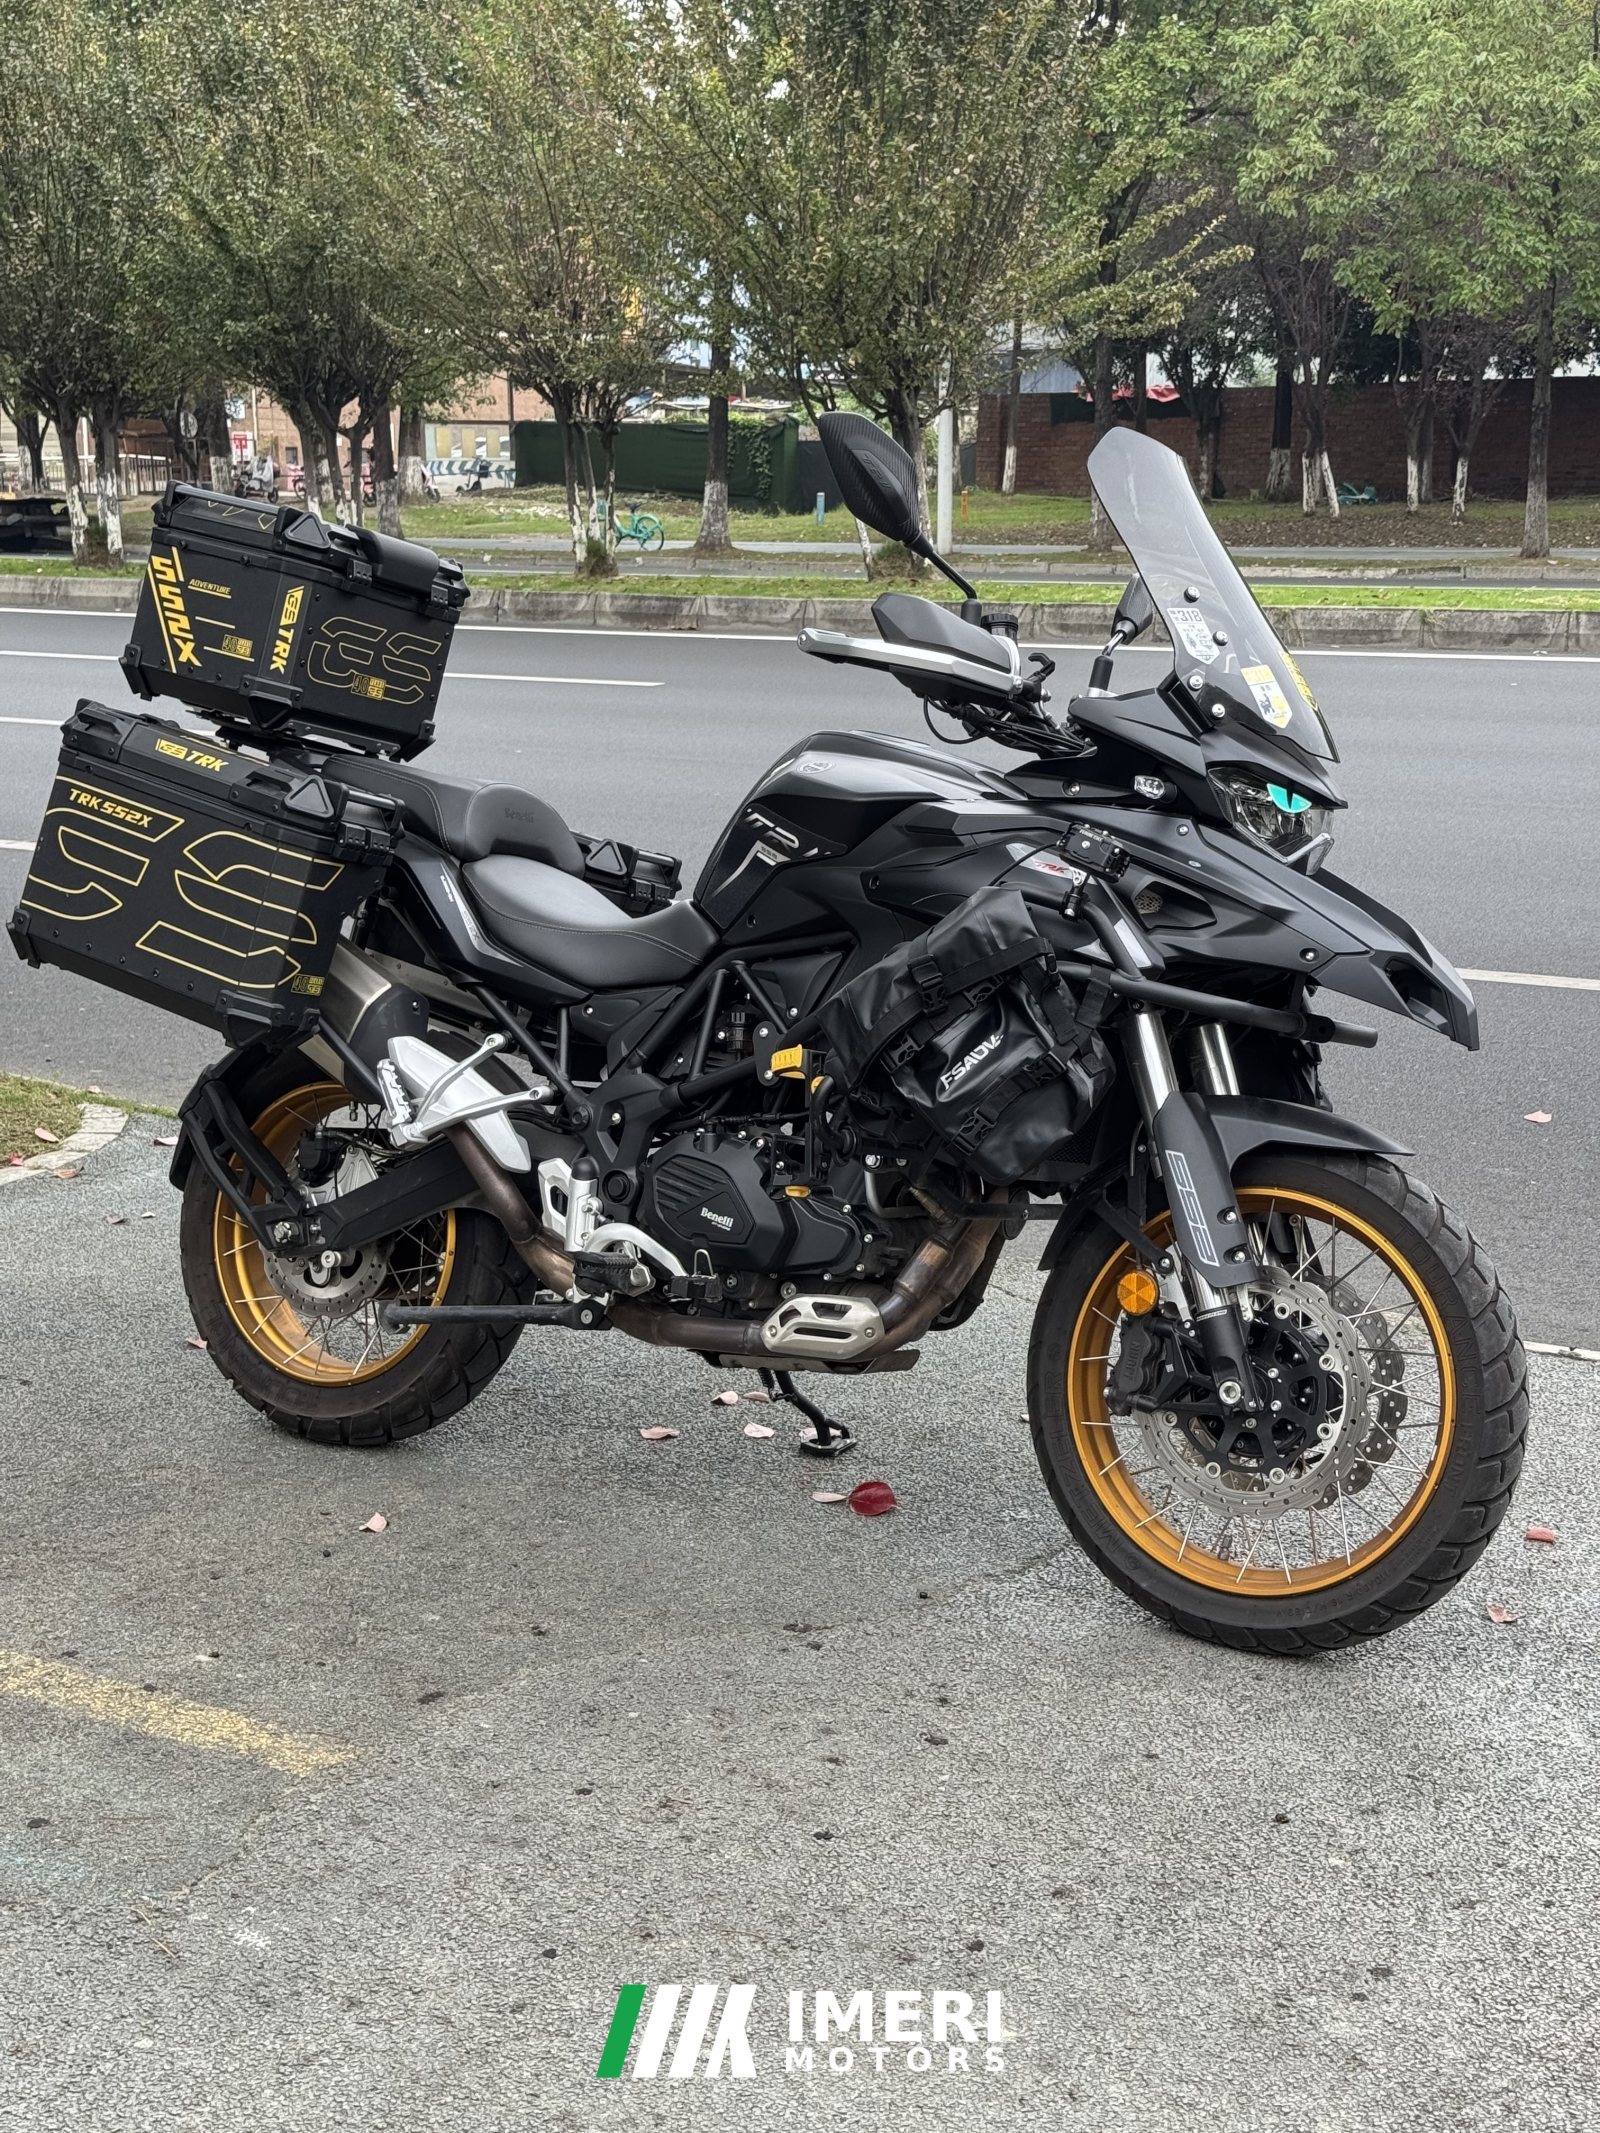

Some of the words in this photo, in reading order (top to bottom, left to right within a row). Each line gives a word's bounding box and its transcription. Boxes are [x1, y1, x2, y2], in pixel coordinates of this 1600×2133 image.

[189, 578, 232, 595] ADVENTURE
[283, 594, 299, 622] GS
[1177, 610, 1202, 622] 318
[269, 628, 294, 675] TRK
[185, 750, 229, 772] TRK
[700, 1206, 734, 1228] Benelli
